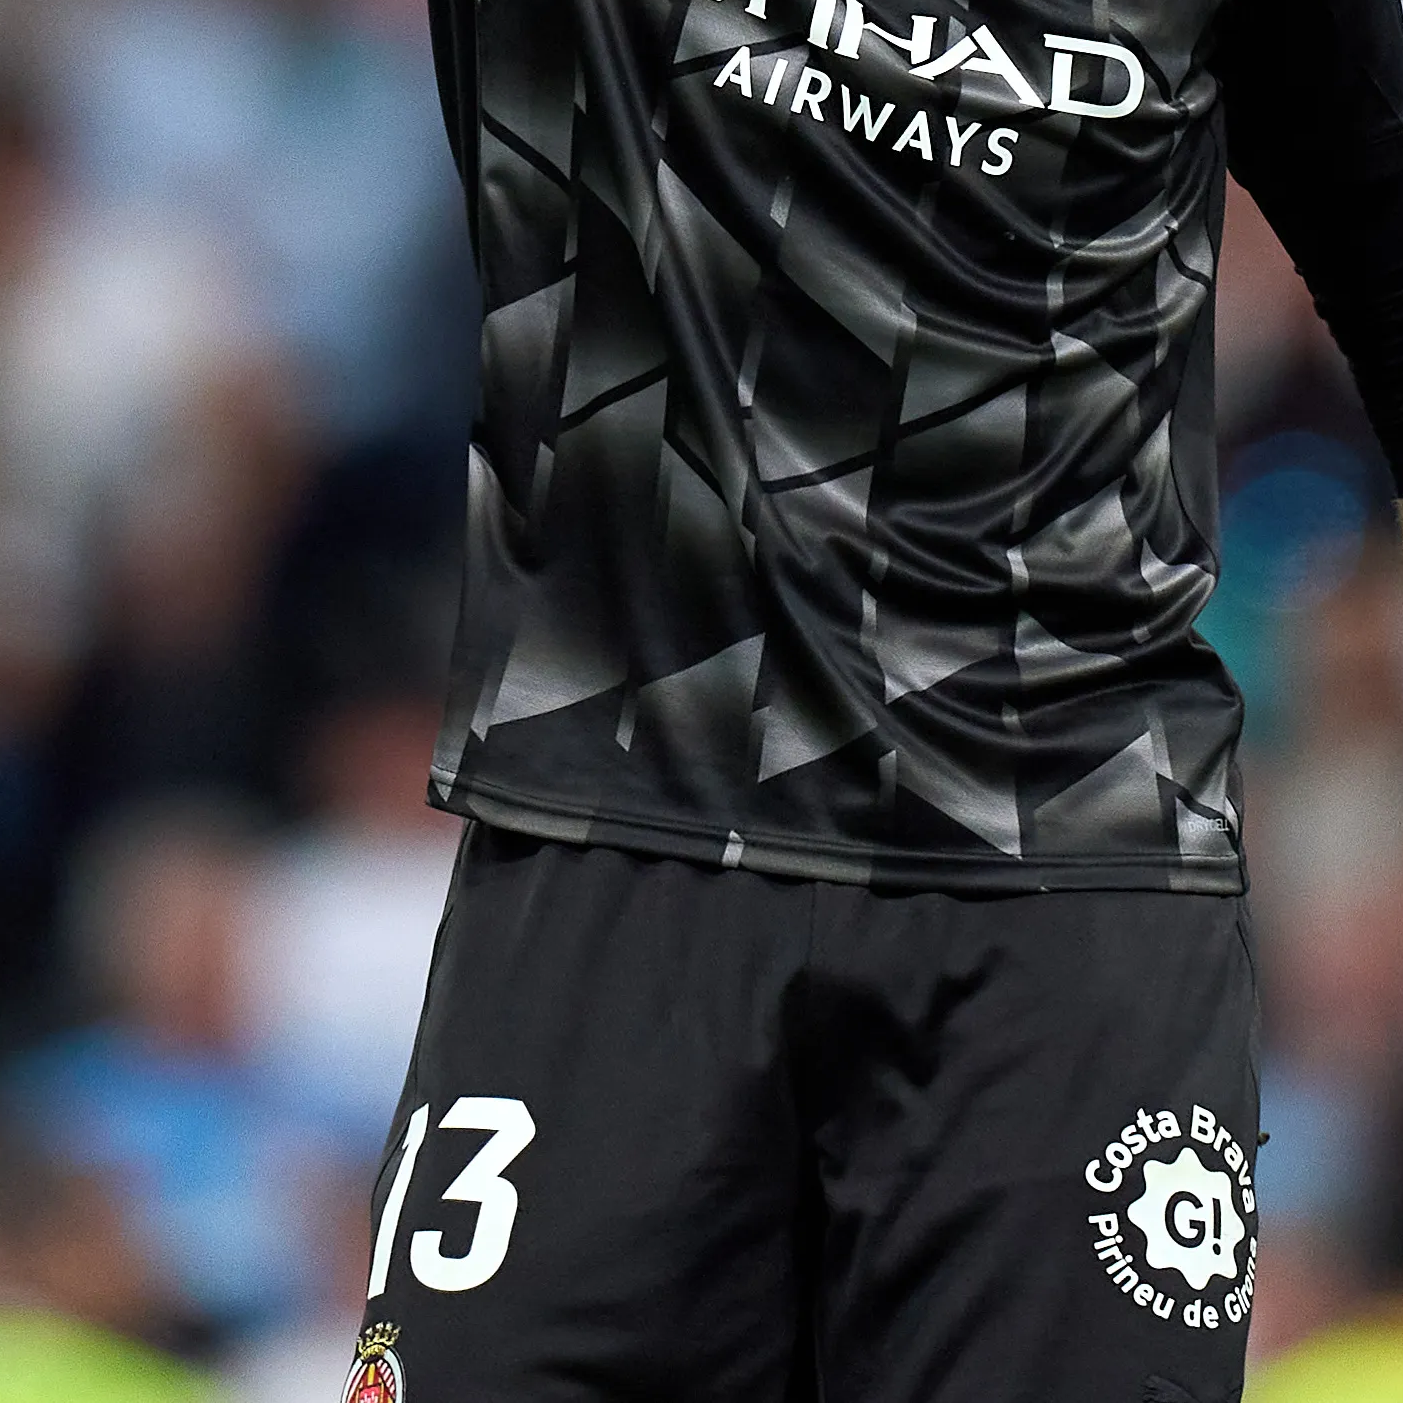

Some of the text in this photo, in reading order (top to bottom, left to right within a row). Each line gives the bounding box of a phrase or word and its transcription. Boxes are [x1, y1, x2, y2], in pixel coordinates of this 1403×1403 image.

[713, 45, 1019, 176] AIRWAYS
[367, 1096, 536, 1300] 13
[1084, 1104, 1256, 1214] Costa Brava
[1088, 1212, 1175, 1320] Pirineu
[1183, 1299, 1220, 1329] de
[1164, 1190, 1222, 1256] G!
